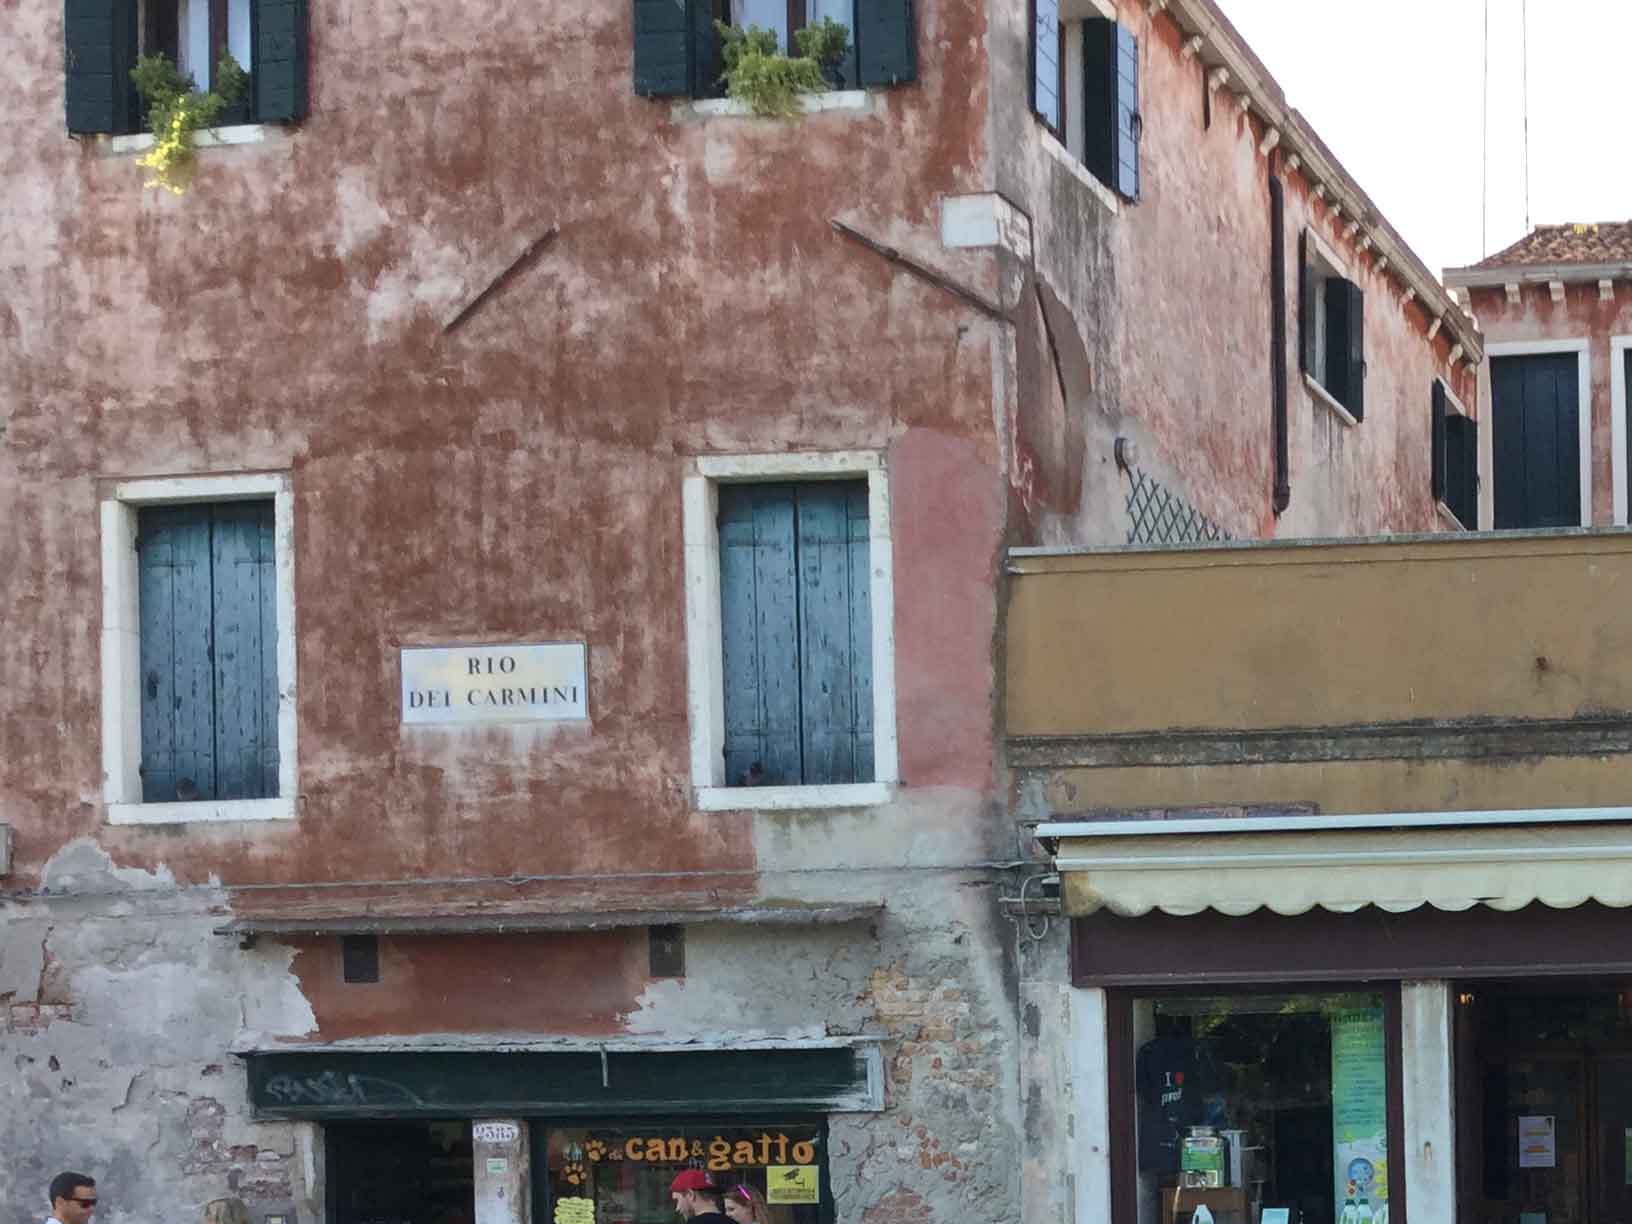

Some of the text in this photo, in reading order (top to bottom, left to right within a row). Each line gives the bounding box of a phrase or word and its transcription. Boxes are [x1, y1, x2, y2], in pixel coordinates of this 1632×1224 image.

[468, 656, 516, 675] RIO
[409, 686, 577, 708] DEI CARMINI
